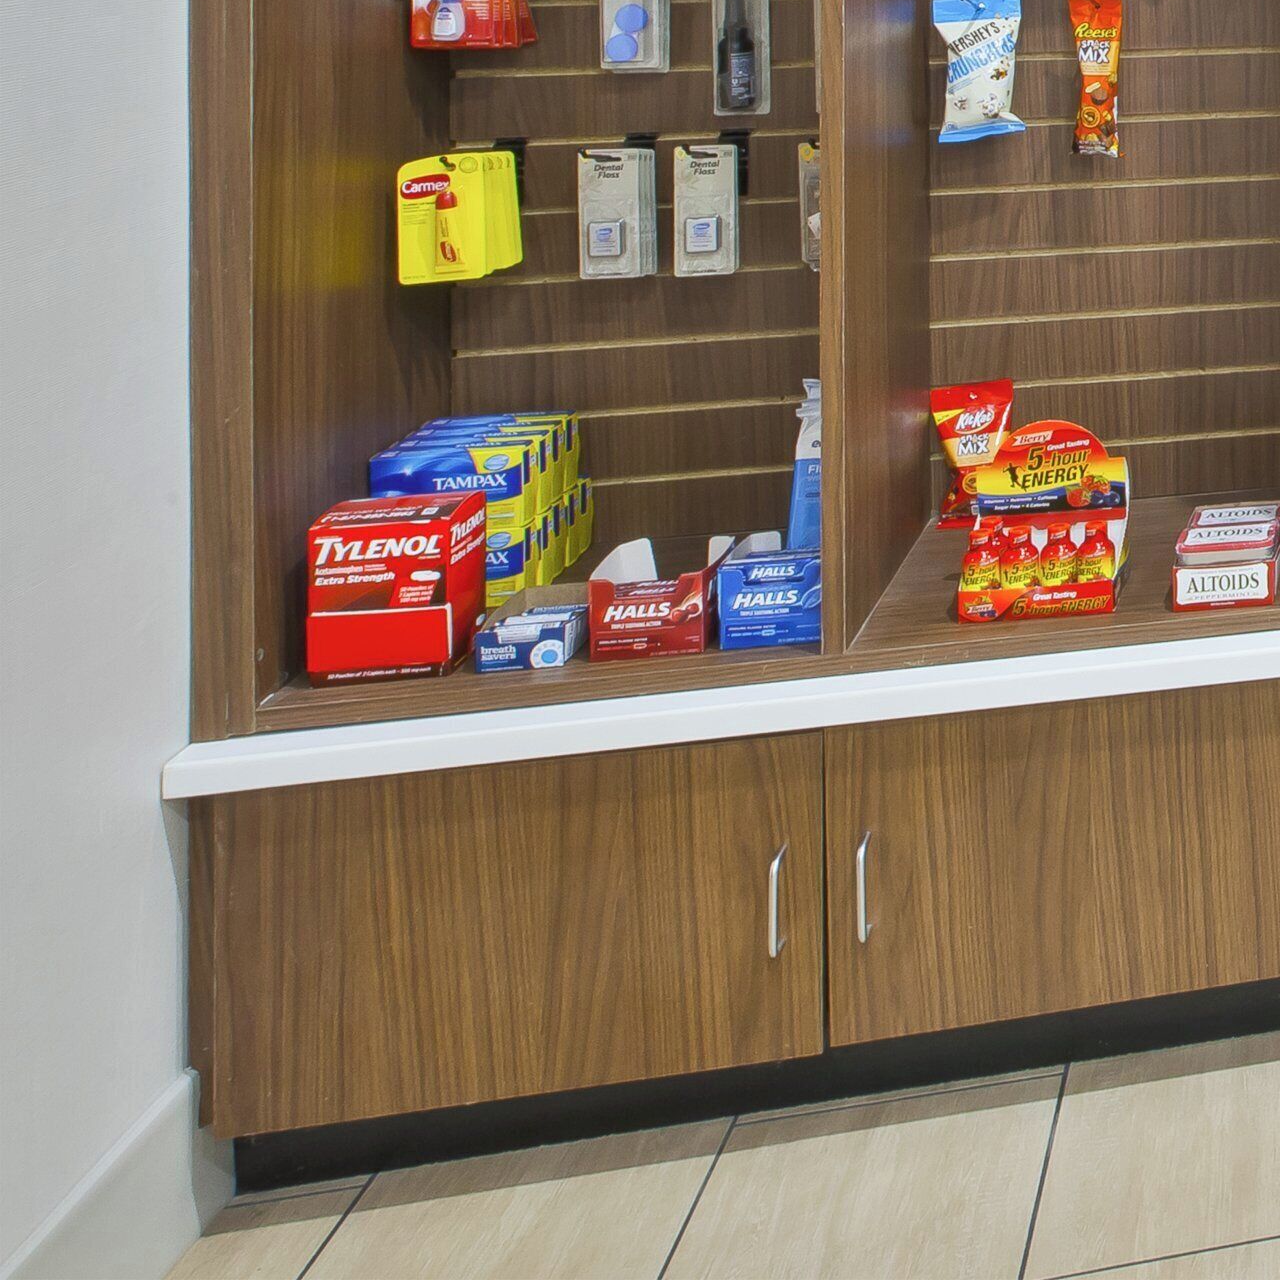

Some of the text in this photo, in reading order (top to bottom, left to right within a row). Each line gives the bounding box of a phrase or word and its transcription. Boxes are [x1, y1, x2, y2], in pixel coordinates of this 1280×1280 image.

[594, 163, 624, 172] Dental
[690, 160, 720, 168] Dental
[597, 171, 621, 179] Floss
[694, 168, 717, 176] Floss
[402, 181, 450, 194] Carmex
[1018, 433, 1051, 444] Berry
[1046, 439, 1090, 451] Great Tasting
[1027, 447, 1090, 470] 5-hour
[432, 473, 508, 490] TAMPAX
[1021, 464, 1089, 490] ENERGY
[1206, 509, 1273, 519] ALTOIDS
[450, 508, 486, 547] TYLENOL
[1192, 528, 1263, 539] ALTOIDS
[314, 535, 441, 566] TYLENOL
[315, 572, 396, 587] Extra Strength
[751, 566, 796, 580] HALLS
[1187, 572, 1259, 593] ALTOIDS
[732, 590, 799, 609] HALLS
[1032, 590, 1077, 601] Great Tasting
[1060, 596, 1110, 612] ENERGY
[603, 602, 672, 623] HALLS
[480, 646, 517, 655] breath
[481, 652, 517, 661] savers
